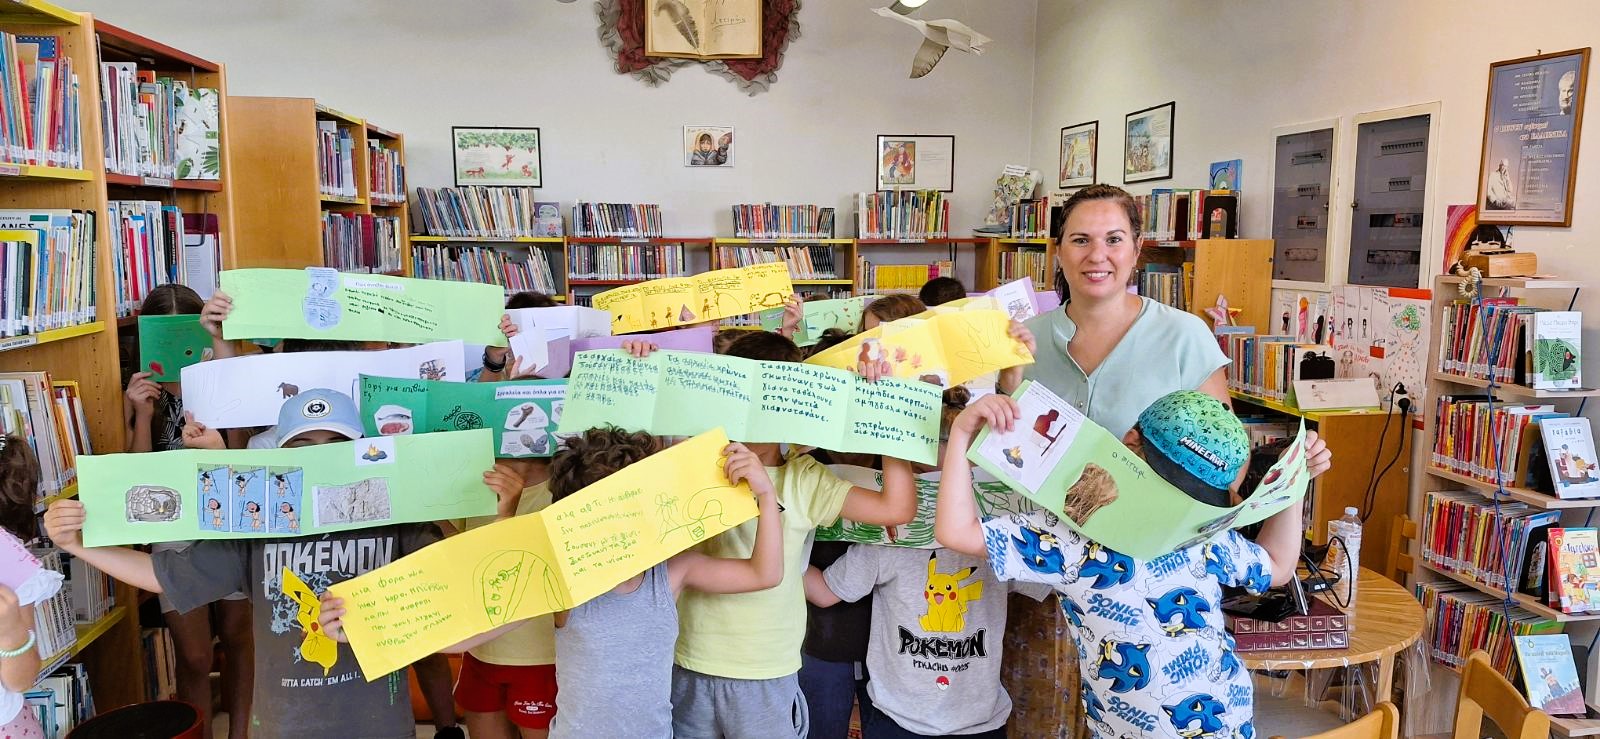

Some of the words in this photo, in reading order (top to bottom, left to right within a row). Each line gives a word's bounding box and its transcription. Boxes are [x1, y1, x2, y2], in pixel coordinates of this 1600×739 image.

[1179, 437, 1228, 471] MINECRAFT
[1153, 551, 1191, 578] SONIC
[1086, 606, 1140, 626] PRIME
[1087, 593, 1143, 617] SONIC
[913, 659, 949, 672] PIKACHU
[1161, 640, 1200, 675] PRIME
[1170, 647, 1209, 684] SONIC
[300, 678, 323, 687] CATCH
[1227, 683, 1251, 697] SONIC
[1107, 696, 1160, 724] SONIC
[1107, 706, 1157, 732] PRIME
